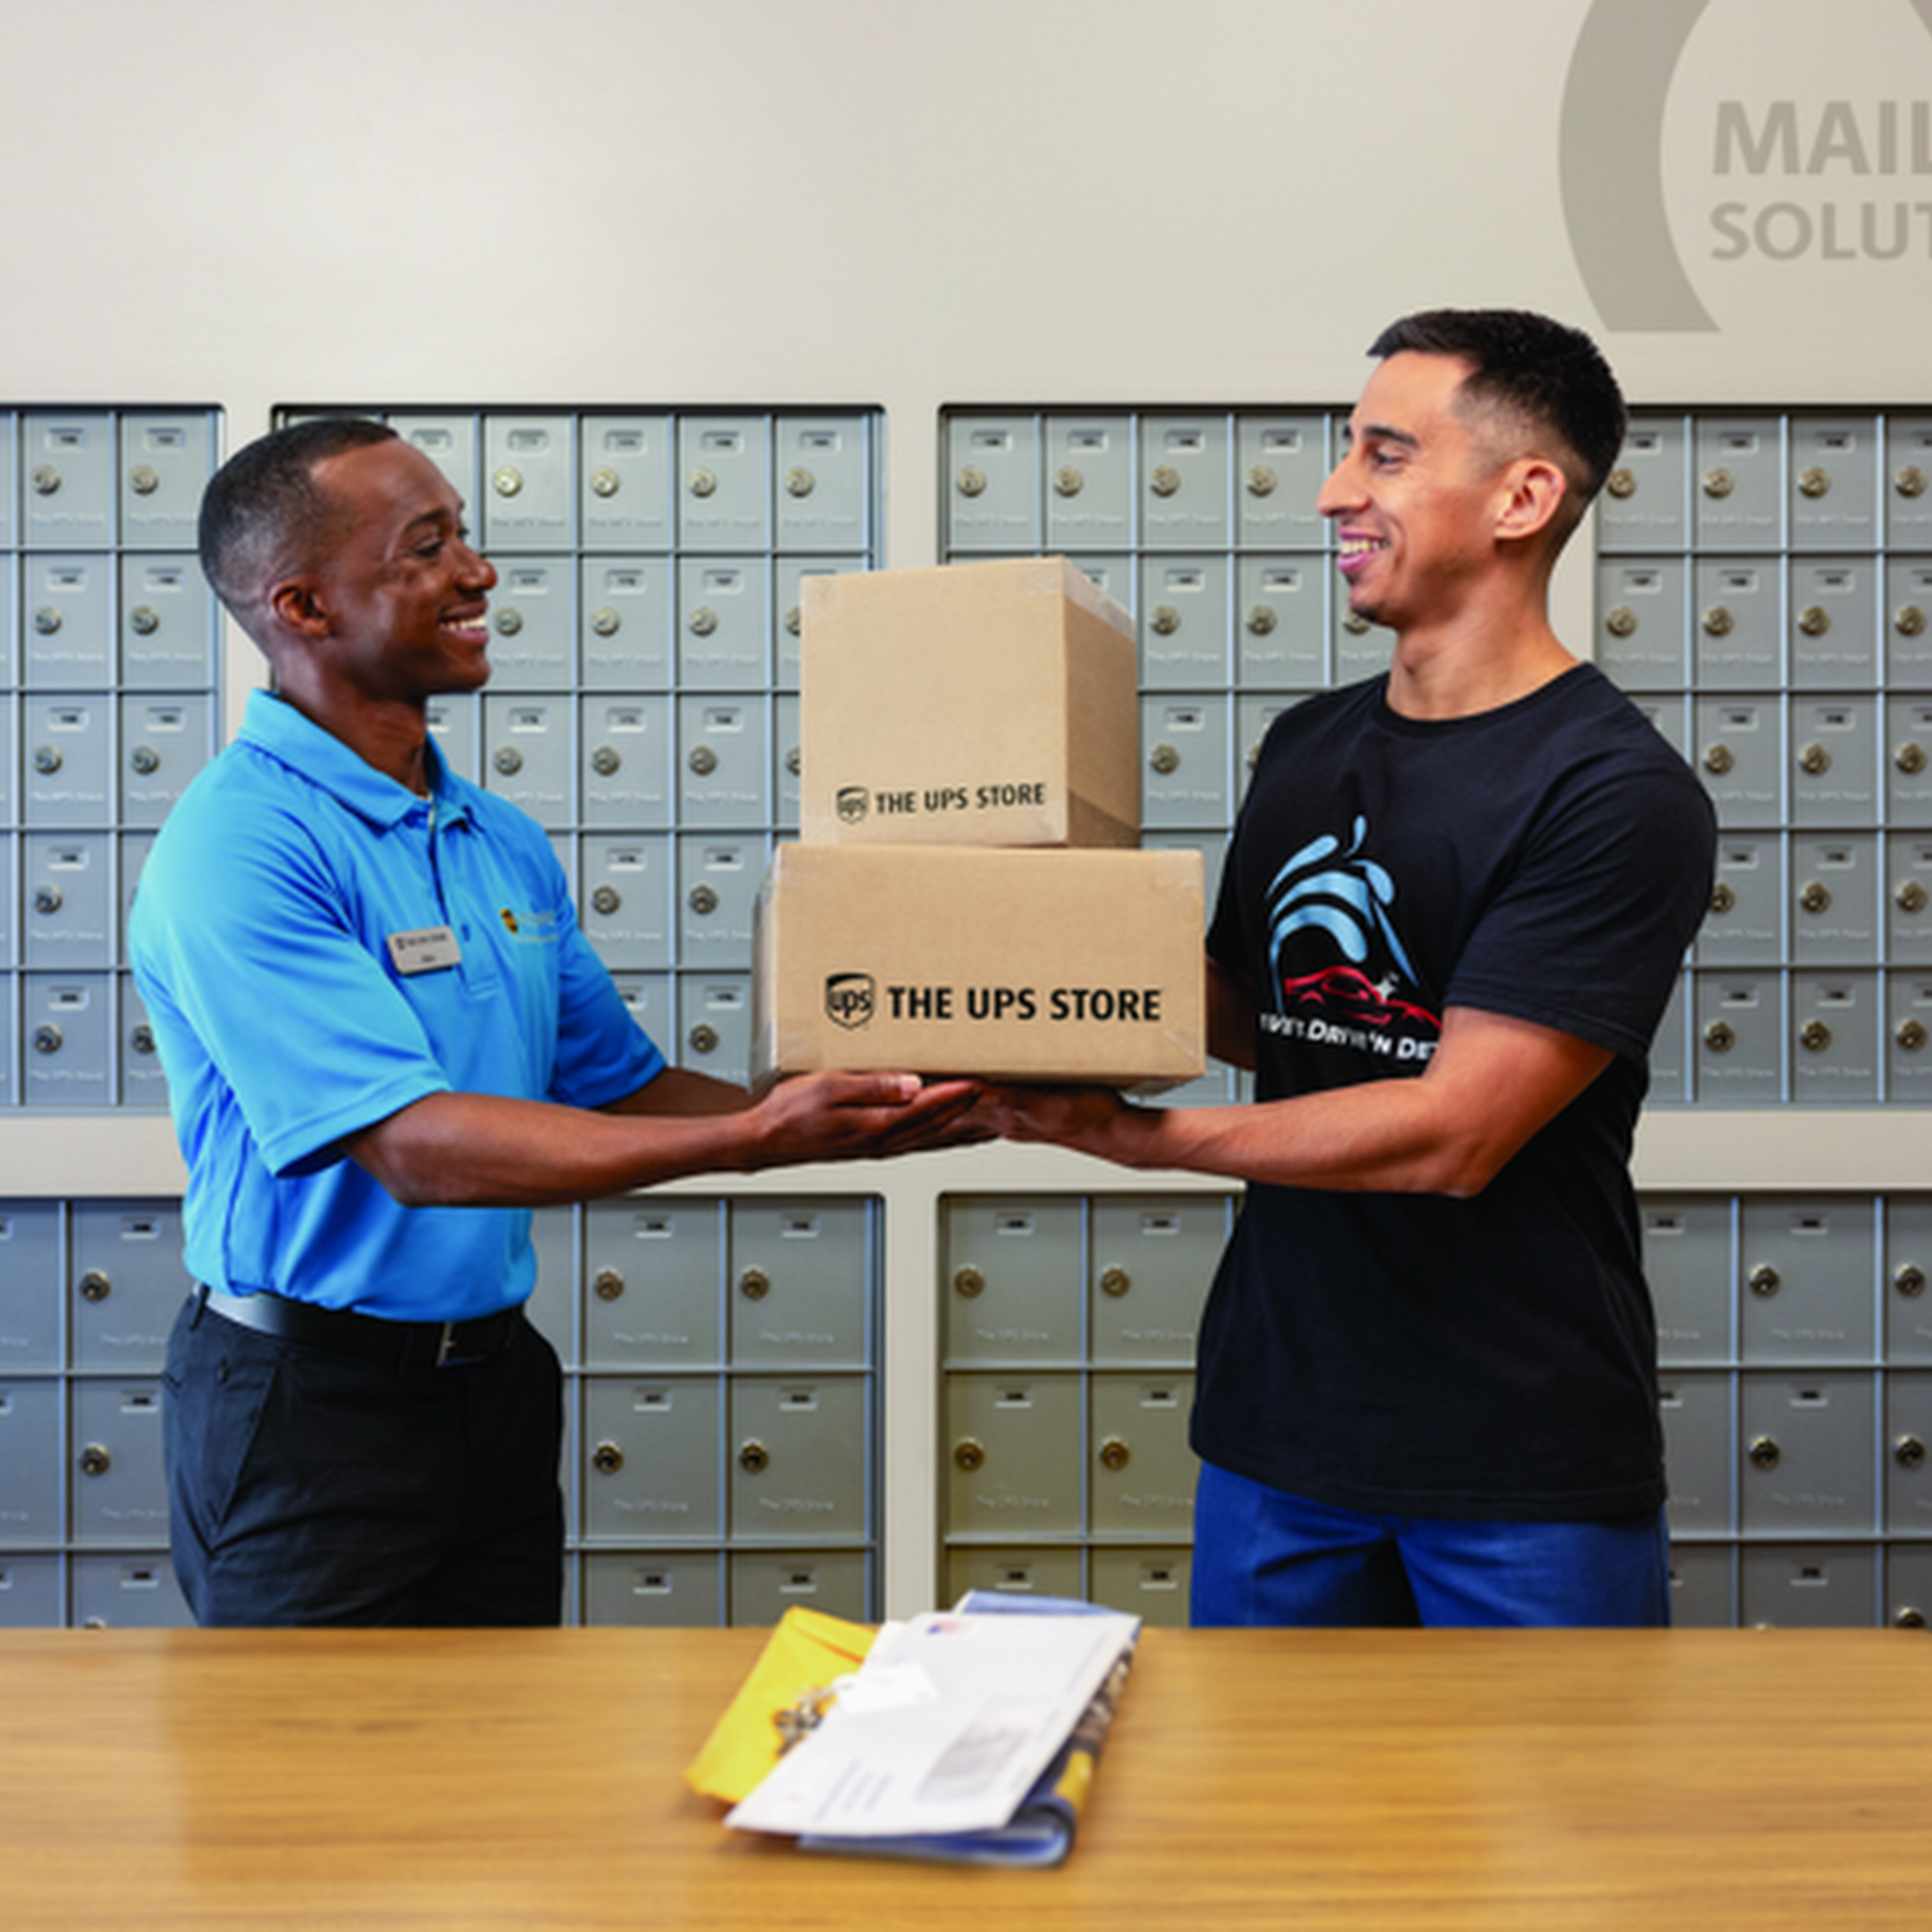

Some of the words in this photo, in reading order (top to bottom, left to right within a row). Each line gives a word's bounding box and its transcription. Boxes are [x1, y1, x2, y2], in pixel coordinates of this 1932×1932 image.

[876, 791, 916, 813] THE
[923, 787, 969, 811] UPS
[976, 782, 1044, 810] STORE
[888, 986, 952, 1019] THE
[967, 988, 1037, 1020] UPS
[1050, 988, 1160, 1021] STORE
